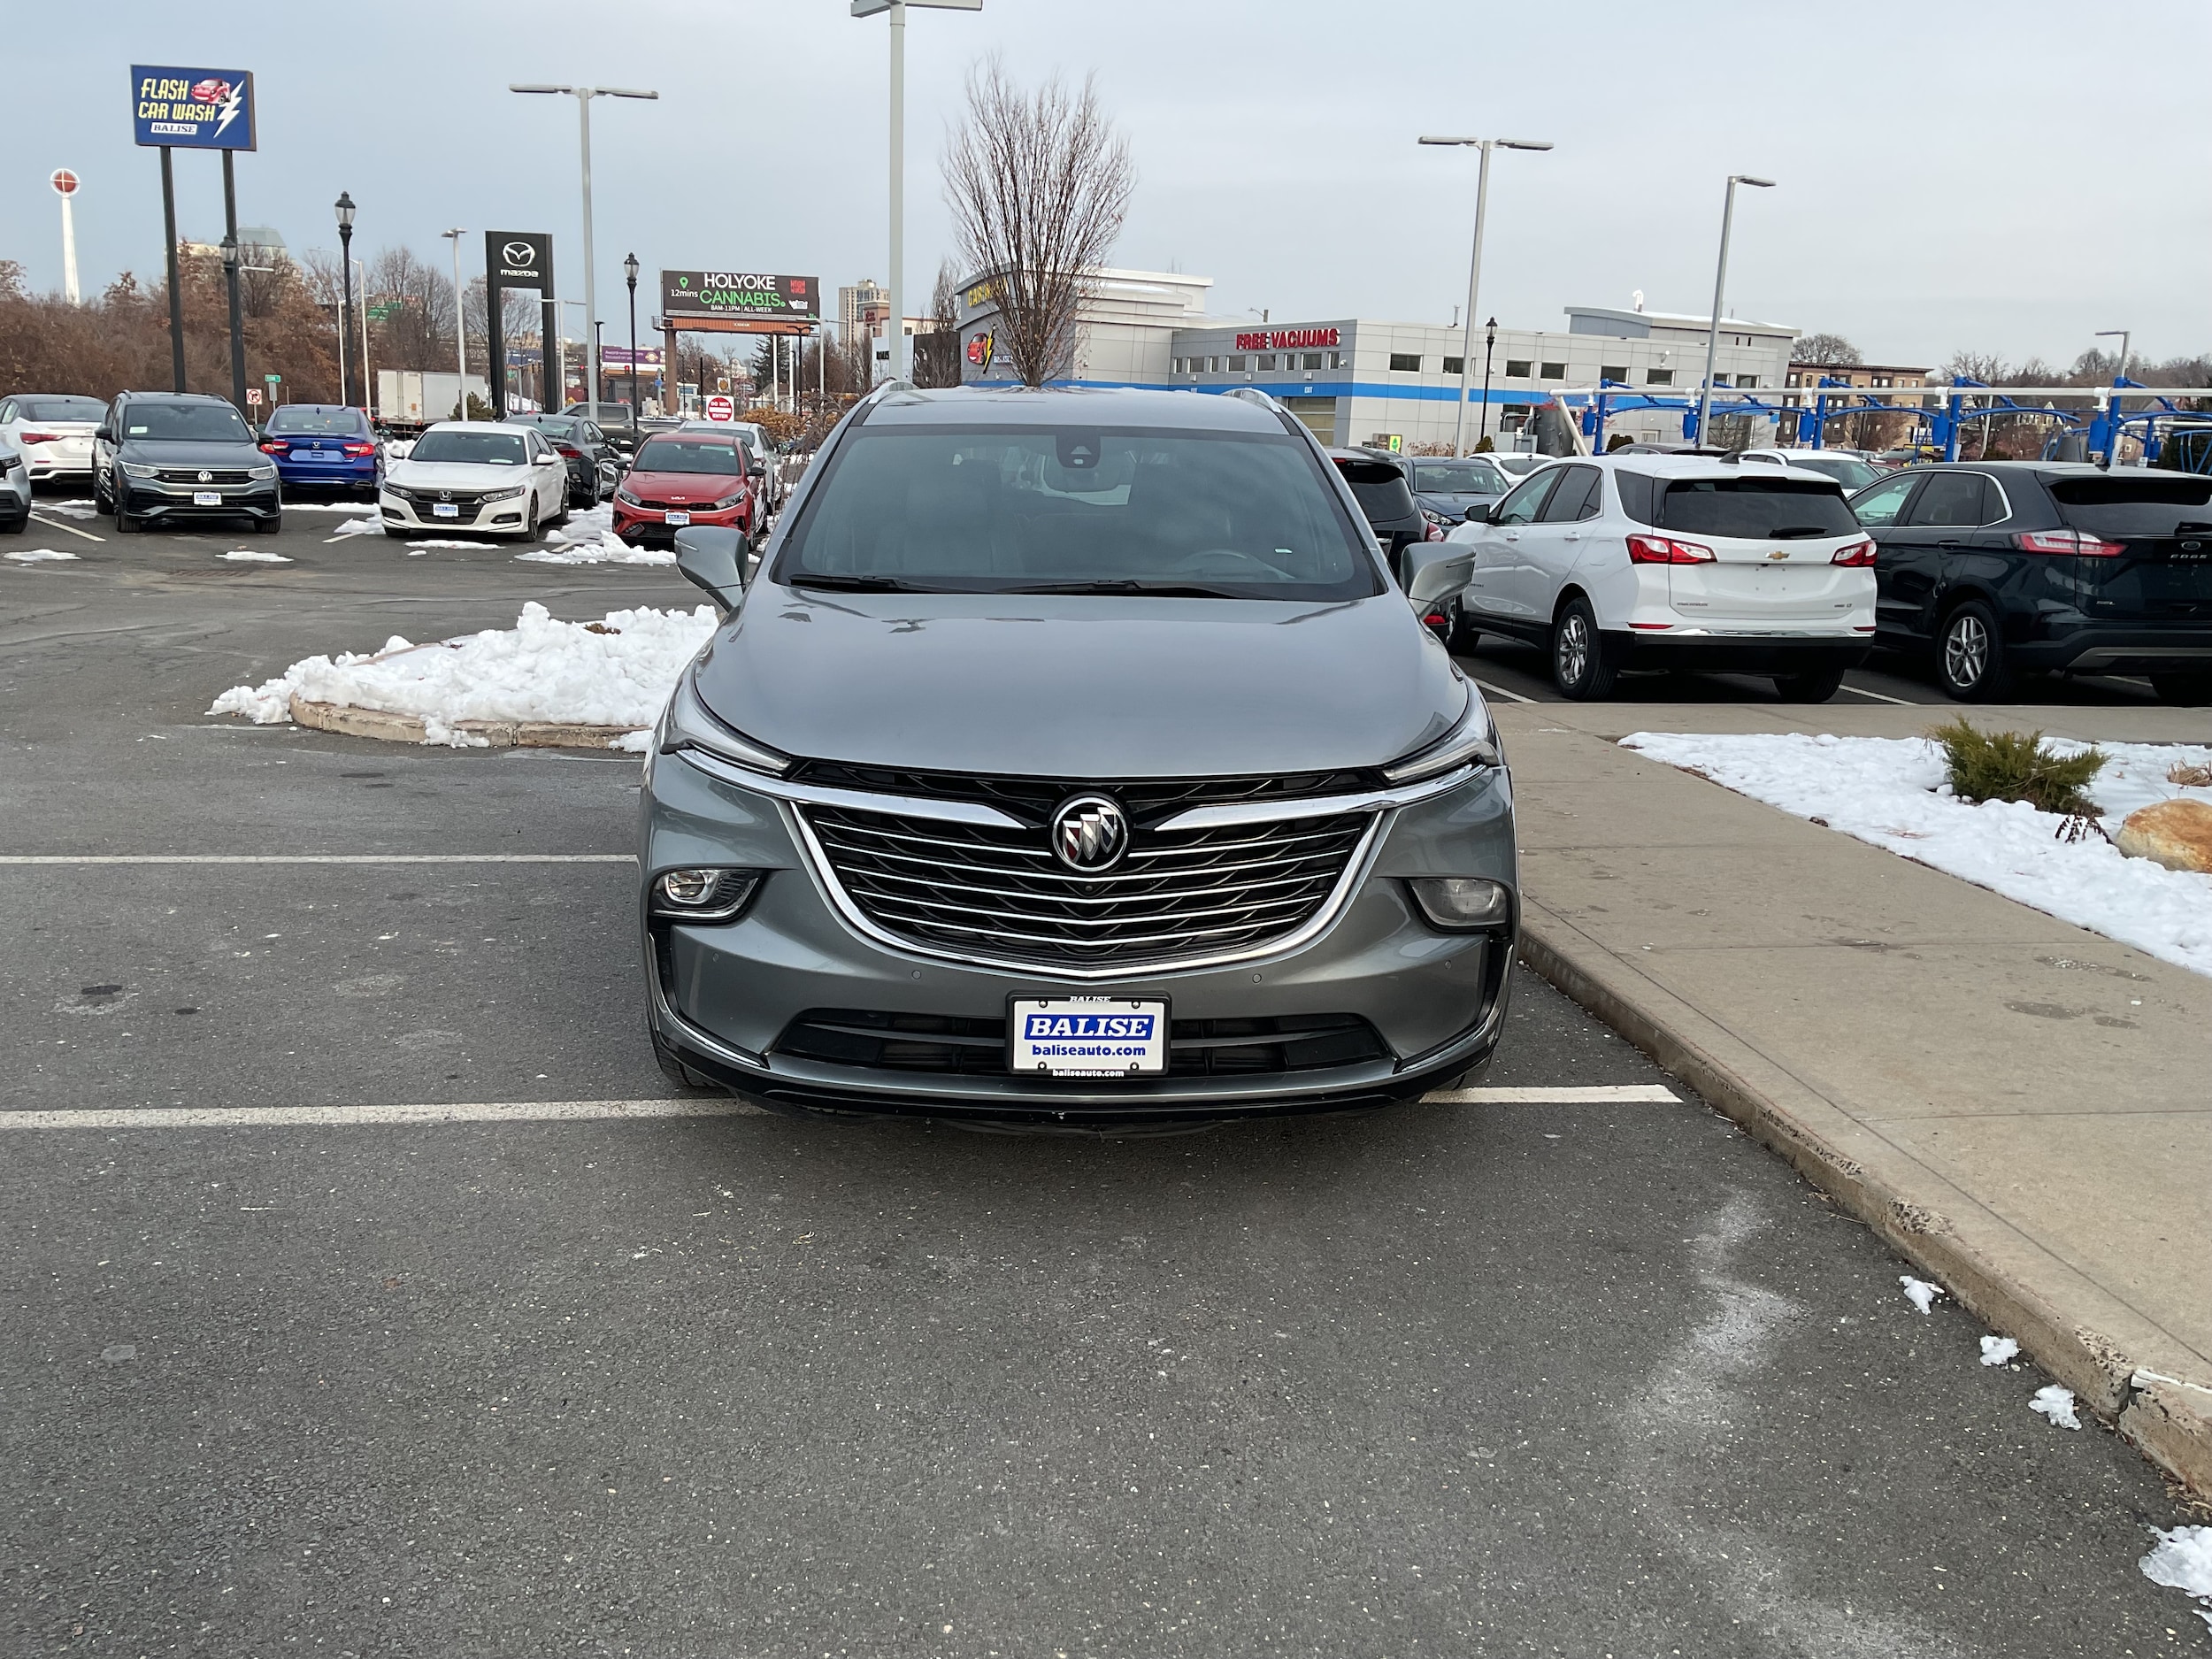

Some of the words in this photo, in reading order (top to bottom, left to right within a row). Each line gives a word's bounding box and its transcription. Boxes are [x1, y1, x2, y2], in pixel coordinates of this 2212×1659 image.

[141, 78, 188, 100] FLASH
[138, 102, 169, 119] CAR
[172, 104, 215, 121] WASH
[153, 124, 195, 133] BALISE
[703, 273, 776, 291] HOLYOKE
[671, 288, 698, 297] 12mins
[1235, 332, 1269, 350] FREE
[1271, 327, 1341, 349] VACUUMS
[1029, 1018, 1149, 1037] BALISE
[1032, 1045, 1146, 1056] baliseauto.com
